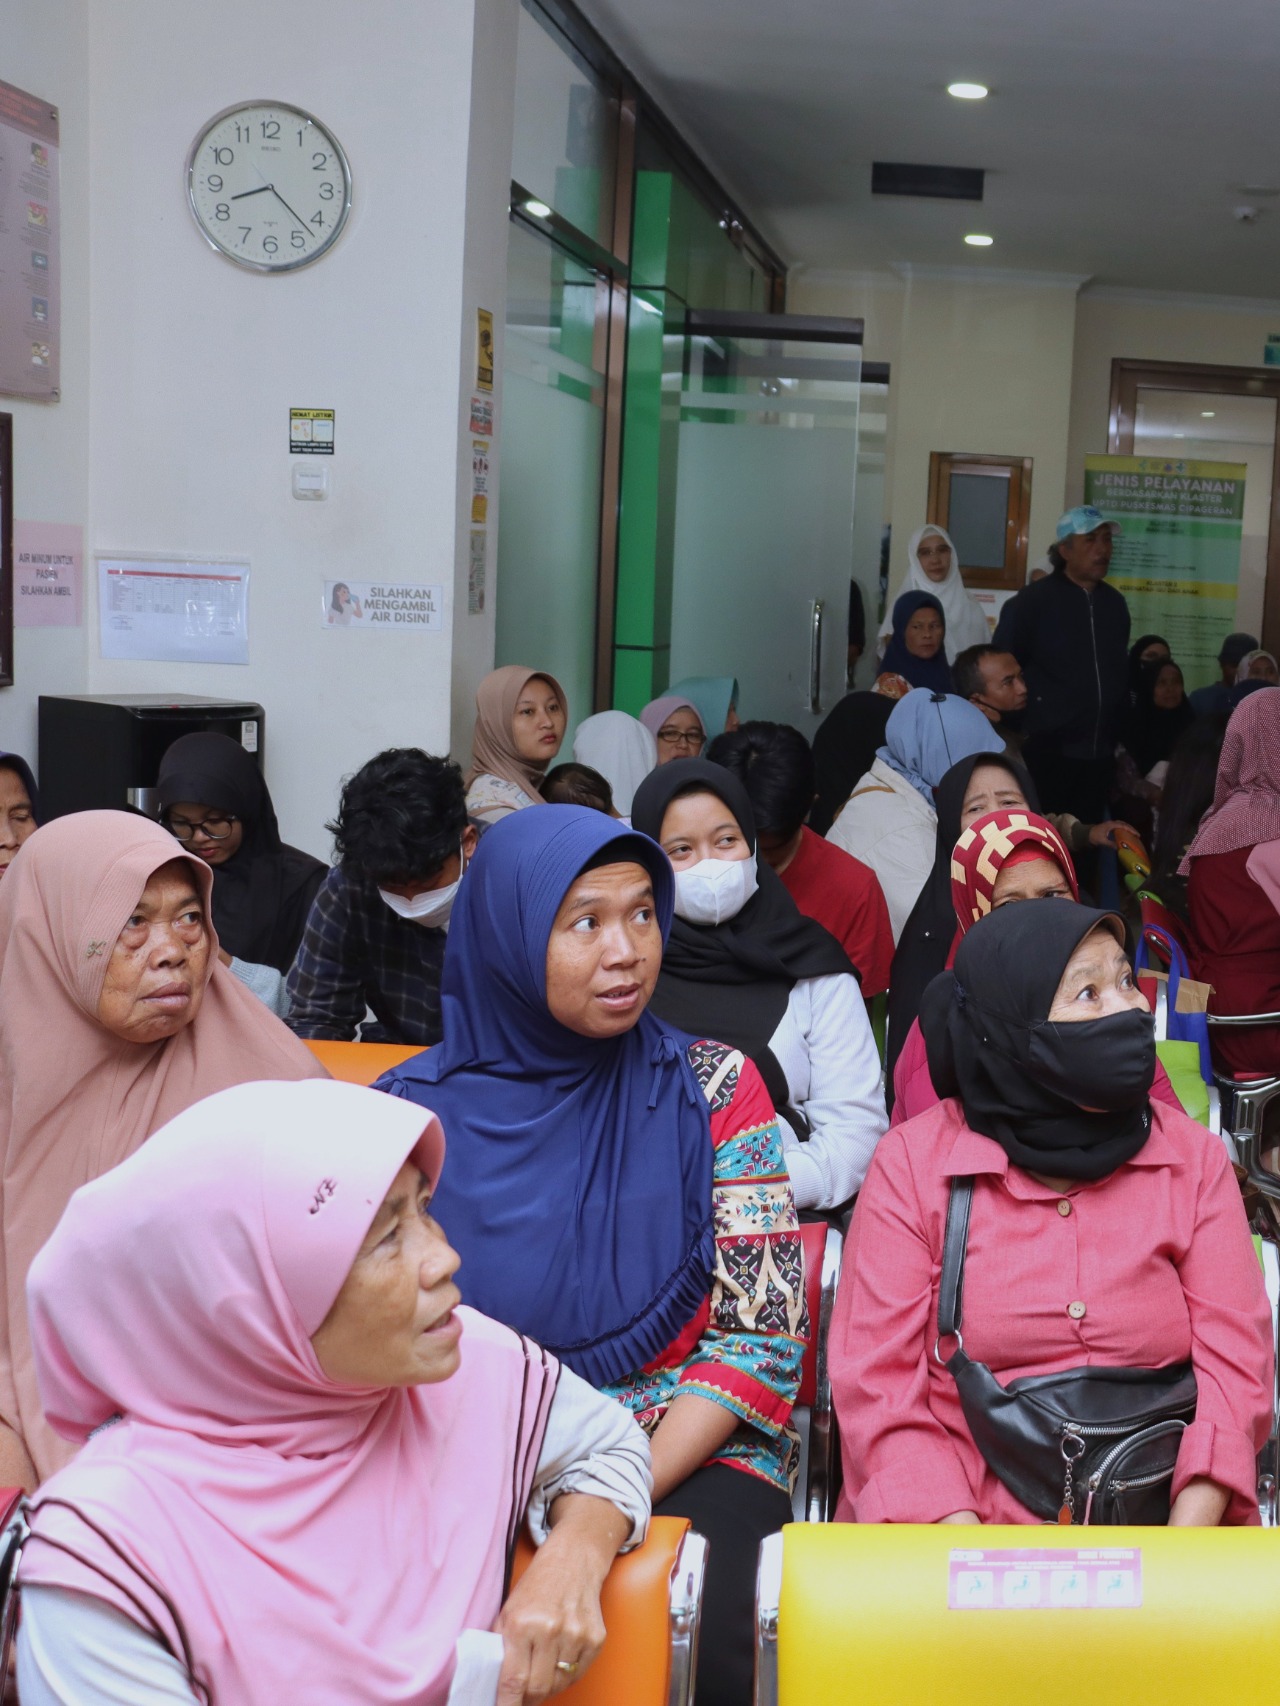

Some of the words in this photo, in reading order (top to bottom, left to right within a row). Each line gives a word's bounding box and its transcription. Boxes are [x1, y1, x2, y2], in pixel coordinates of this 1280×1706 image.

[236, 126, 250, 143] 11
[261, 121, 281, 139] 12
[297, 130, 303, 147] 1
[213, 147, 234, 166] 10
[312, 152, 327, 171] 2
[207, 174, 223, 193] 9
[319, 182, 334, 200] 3
[215, 203, 230, 221] 8
[310, 210, 325, 227] 4
[238, 226, 252, 244] 7
[291, 231, 305, 248] 5
[263, 236, 279, 254] 6
[1094, 474, 1139, 488] JENIS
[1144, 477, 1235, 494] PELAYANAN
[1106, 488, 1178, 499] BERDASARKAN
[1180, 493, 1222, 503] KLASTER
[1092, 498, 1117, 507] UPTD
[1122, 501, 1176, 511] PUSKESMAS
[1179, 504, 1233, 515] CIPAGERAN
[19, 553, 30, 562] AIR
[31, 553, 52, 564] MINUM
[53, 554, 73, 565] UNTUK
[36, 569, 58, 579] PASIEN
[21, 585, 53, 596] SILAHKAN
[54, 586, 72, 596] AMBIL
[370, 587, 431, 599] SILAHKAN
[364, 599, 437, 612] MENGAMBIL
[371, 611, 391, 622] AIR
[394, 612, 430, 623] DISINI
